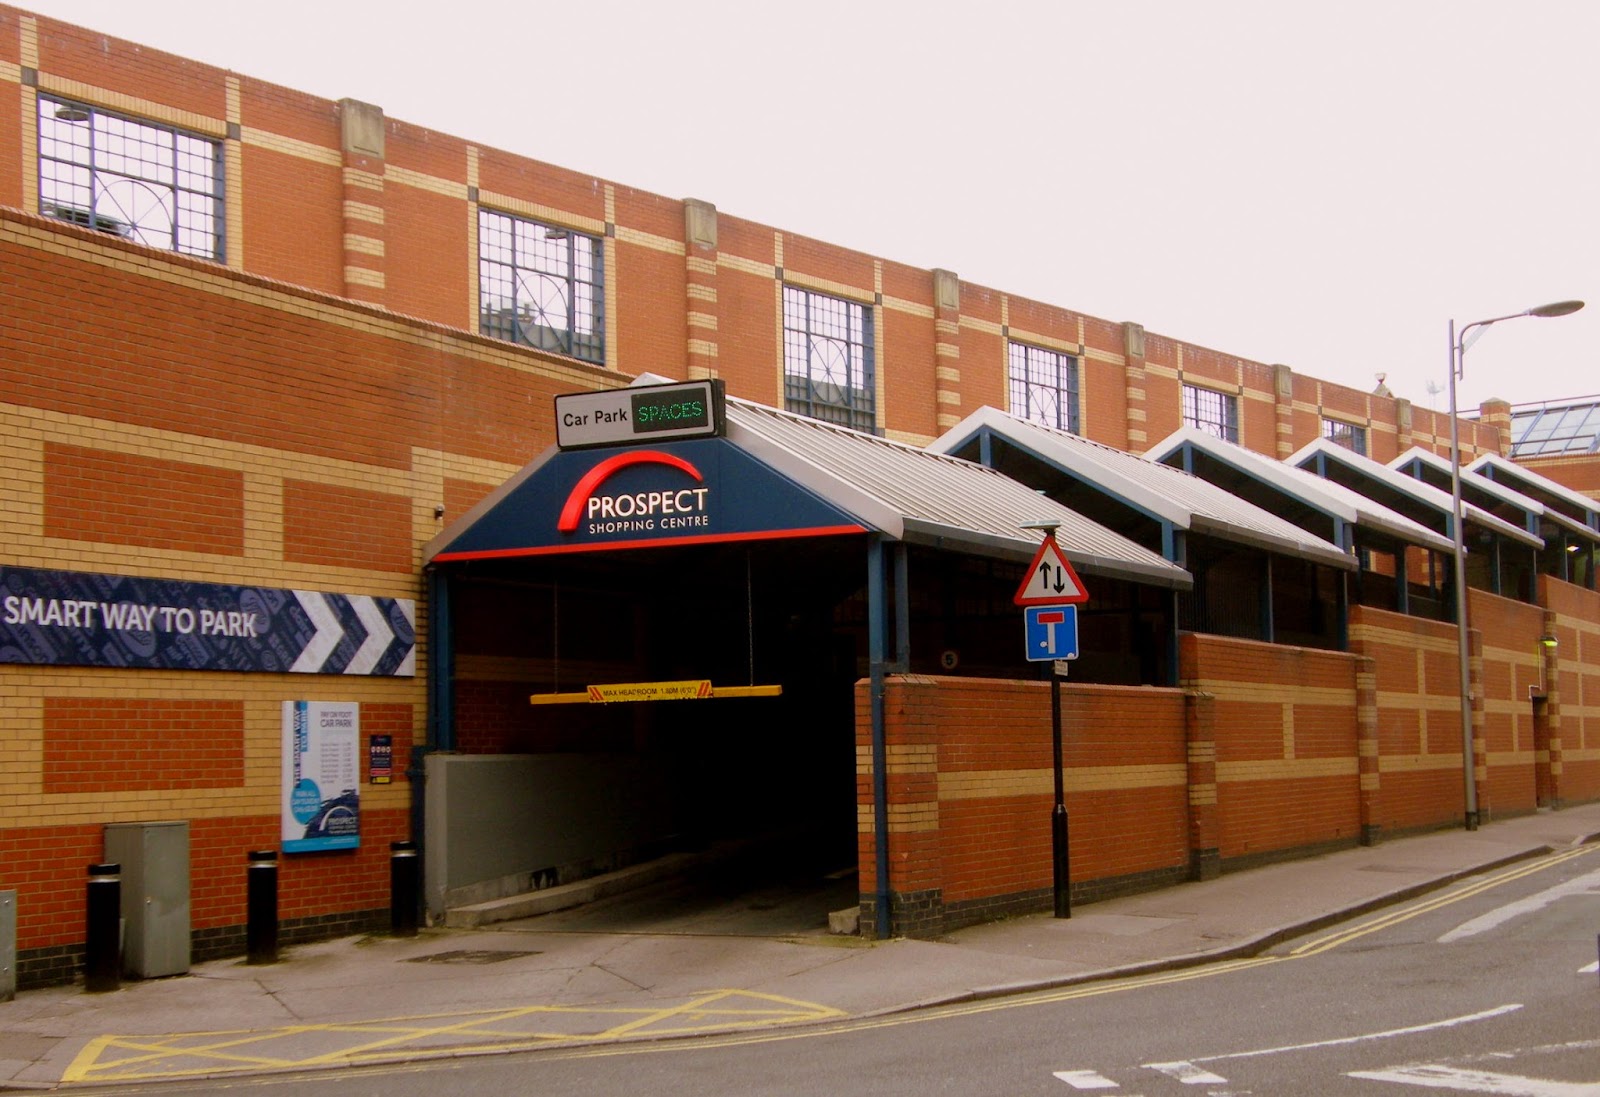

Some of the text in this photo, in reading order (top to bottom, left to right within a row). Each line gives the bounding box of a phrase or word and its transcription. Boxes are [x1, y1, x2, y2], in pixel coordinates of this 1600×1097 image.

[563, 408, 628, 427] Car Park
[638, 401, 702, 422] SPACES
[588, 488, 709, 519] PROSPECT
[589, 515, 709, 535] SHOPPING CENTRE
[4, 595, 97, 628] SMART
[100, 601, 159, 632] WAY
[160, 606, 196, 634] TO
[200, 610, 258, 637] PARK
[945, 653, 954, 666] 5
[618, 688, 658, 696] HEADROOM
[320, 719, 352, 728] CAR PARK
